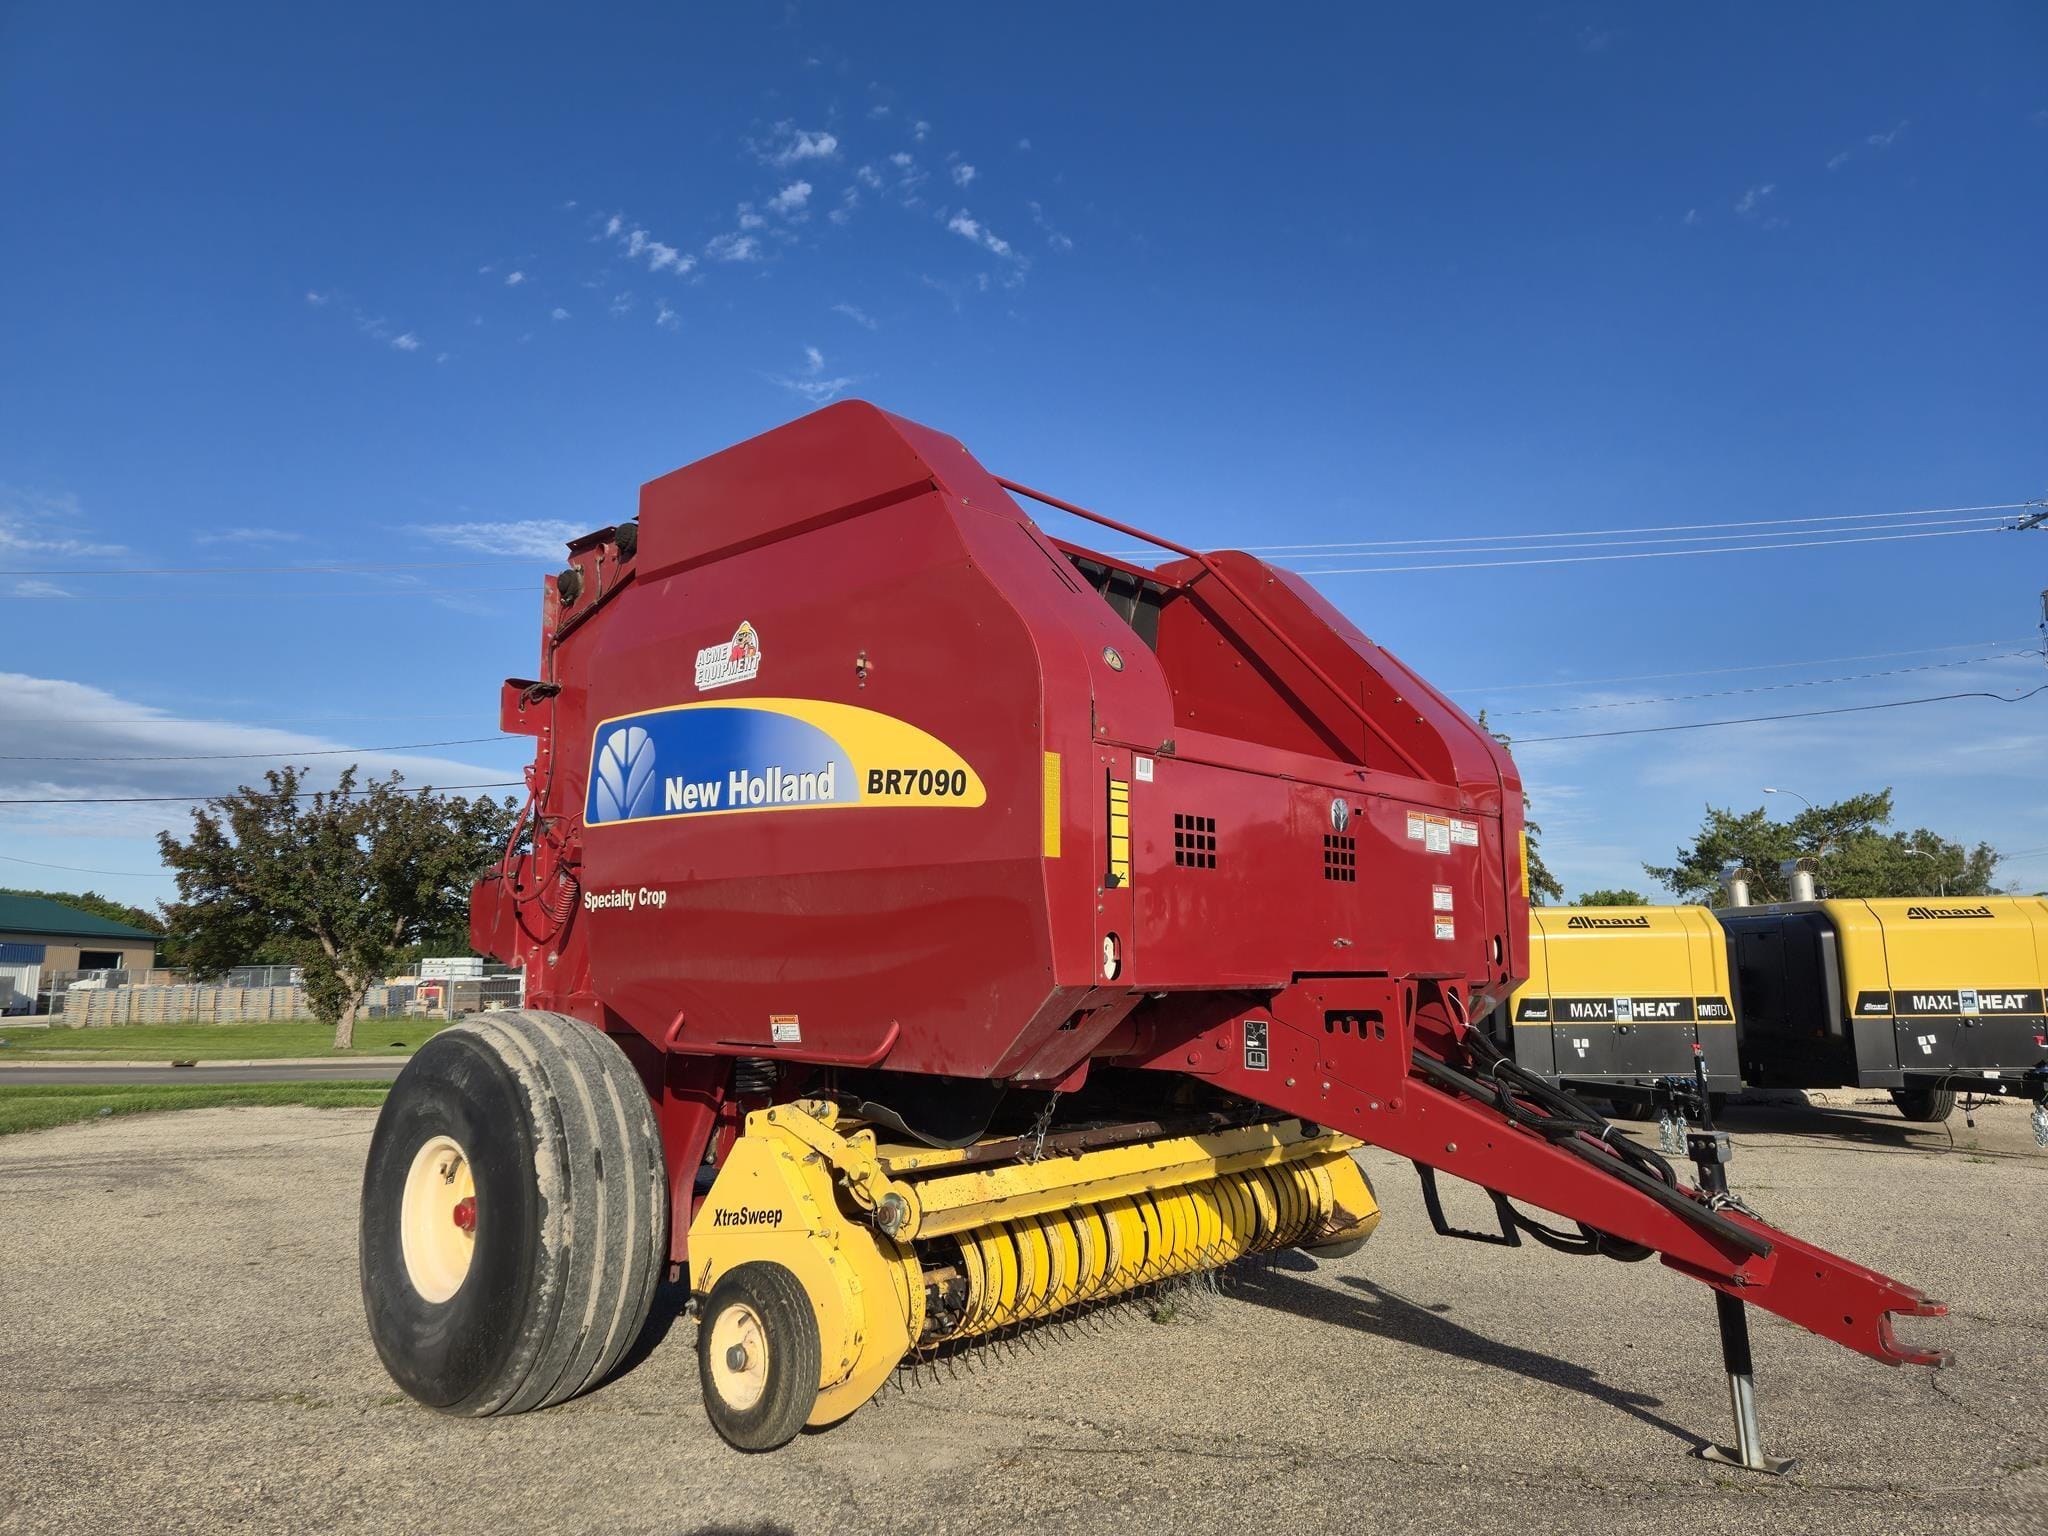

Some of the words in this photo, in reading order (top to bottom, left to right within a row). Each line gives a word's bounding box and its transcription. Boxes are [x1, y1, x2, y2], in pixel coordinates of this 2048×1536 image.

[697, 646, 729, 667] ACME
[696, 655, 760, 684] EQUIPMENT
[665, 776, 721, 811] New
[728, 762, 834, 805] Holland
[867, 769, 967, 796] BR7090
[584, 888, 636, 913] Specialty
[638, 887, 667, 909] Crop
[1568, 916, 1650, 928] Allmand
[1907, 906, 1992, 919] Allmand
[1570, 1003, 1614, 1018] MAXI-
[1632, 1002, 1676, 1017] HEAT
[1697, 1004, 1728, 1017] 1MBTU
[1913, 995, 1958, 1010] MAXI-
[1979, 994, 2024, 1009] HEAT
[713, 1206, 783, 1229] XtraSweep
